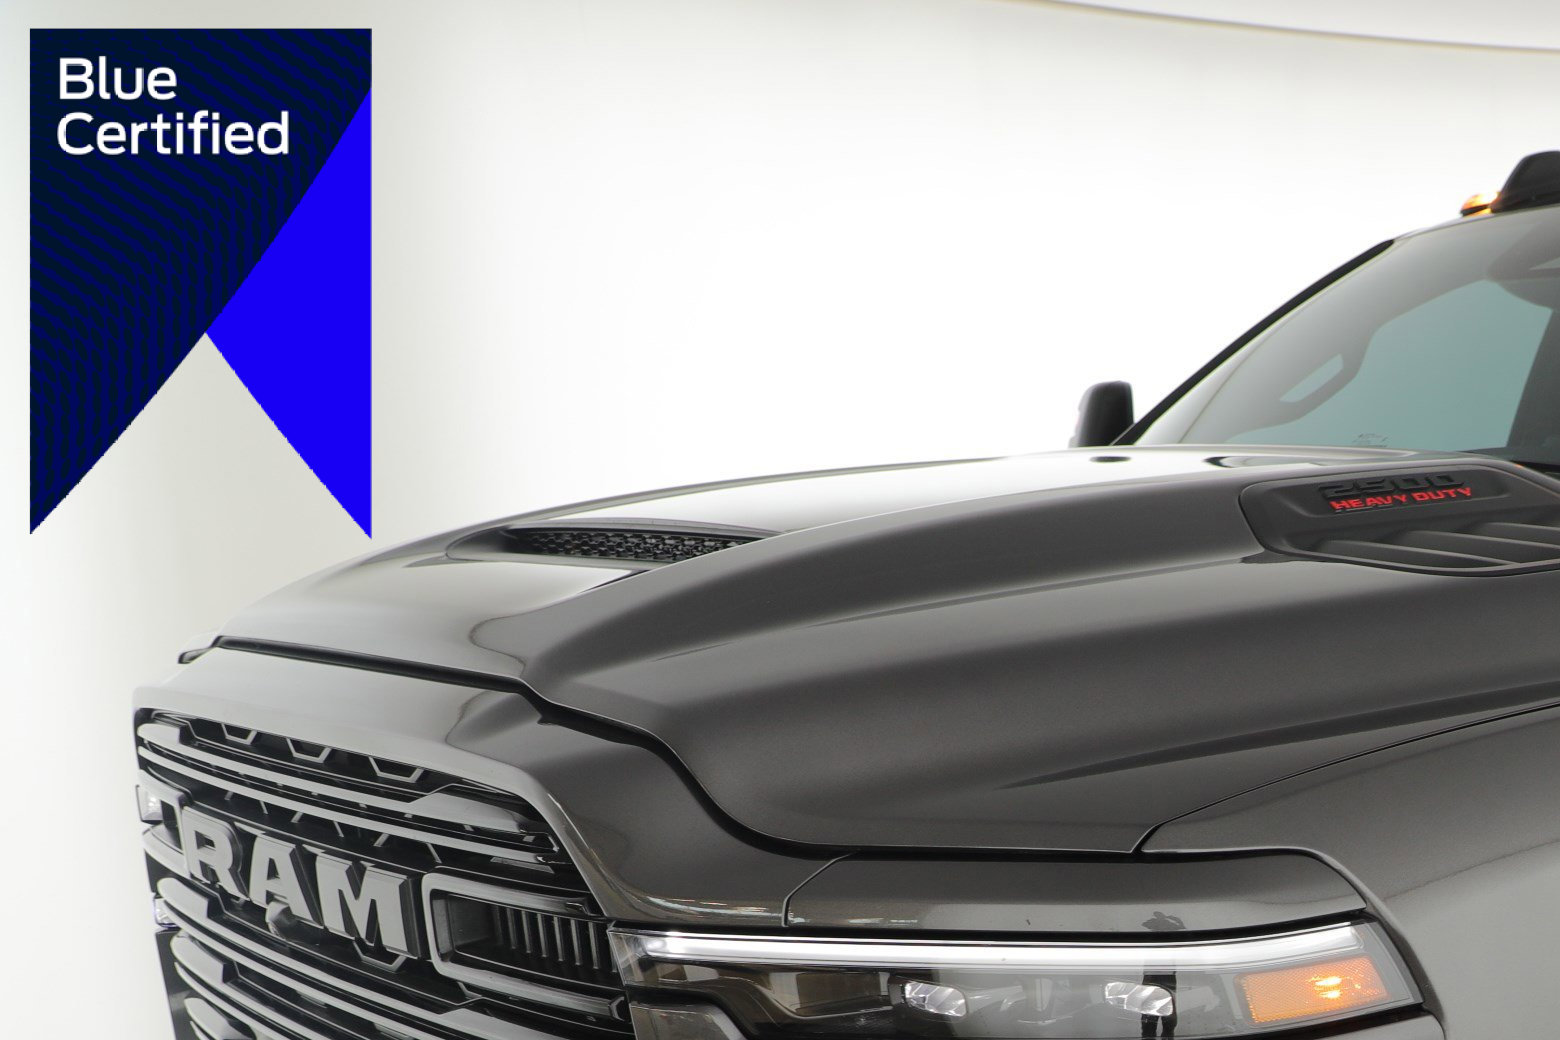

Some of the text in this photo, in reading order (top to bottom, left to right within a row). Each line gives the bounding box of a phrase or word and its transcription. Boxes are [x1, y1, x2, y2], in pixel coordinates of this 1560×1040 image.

[1329, 487, 1472, 511] HEAVY DUTY
[180, 805, 419, 959] RAM
